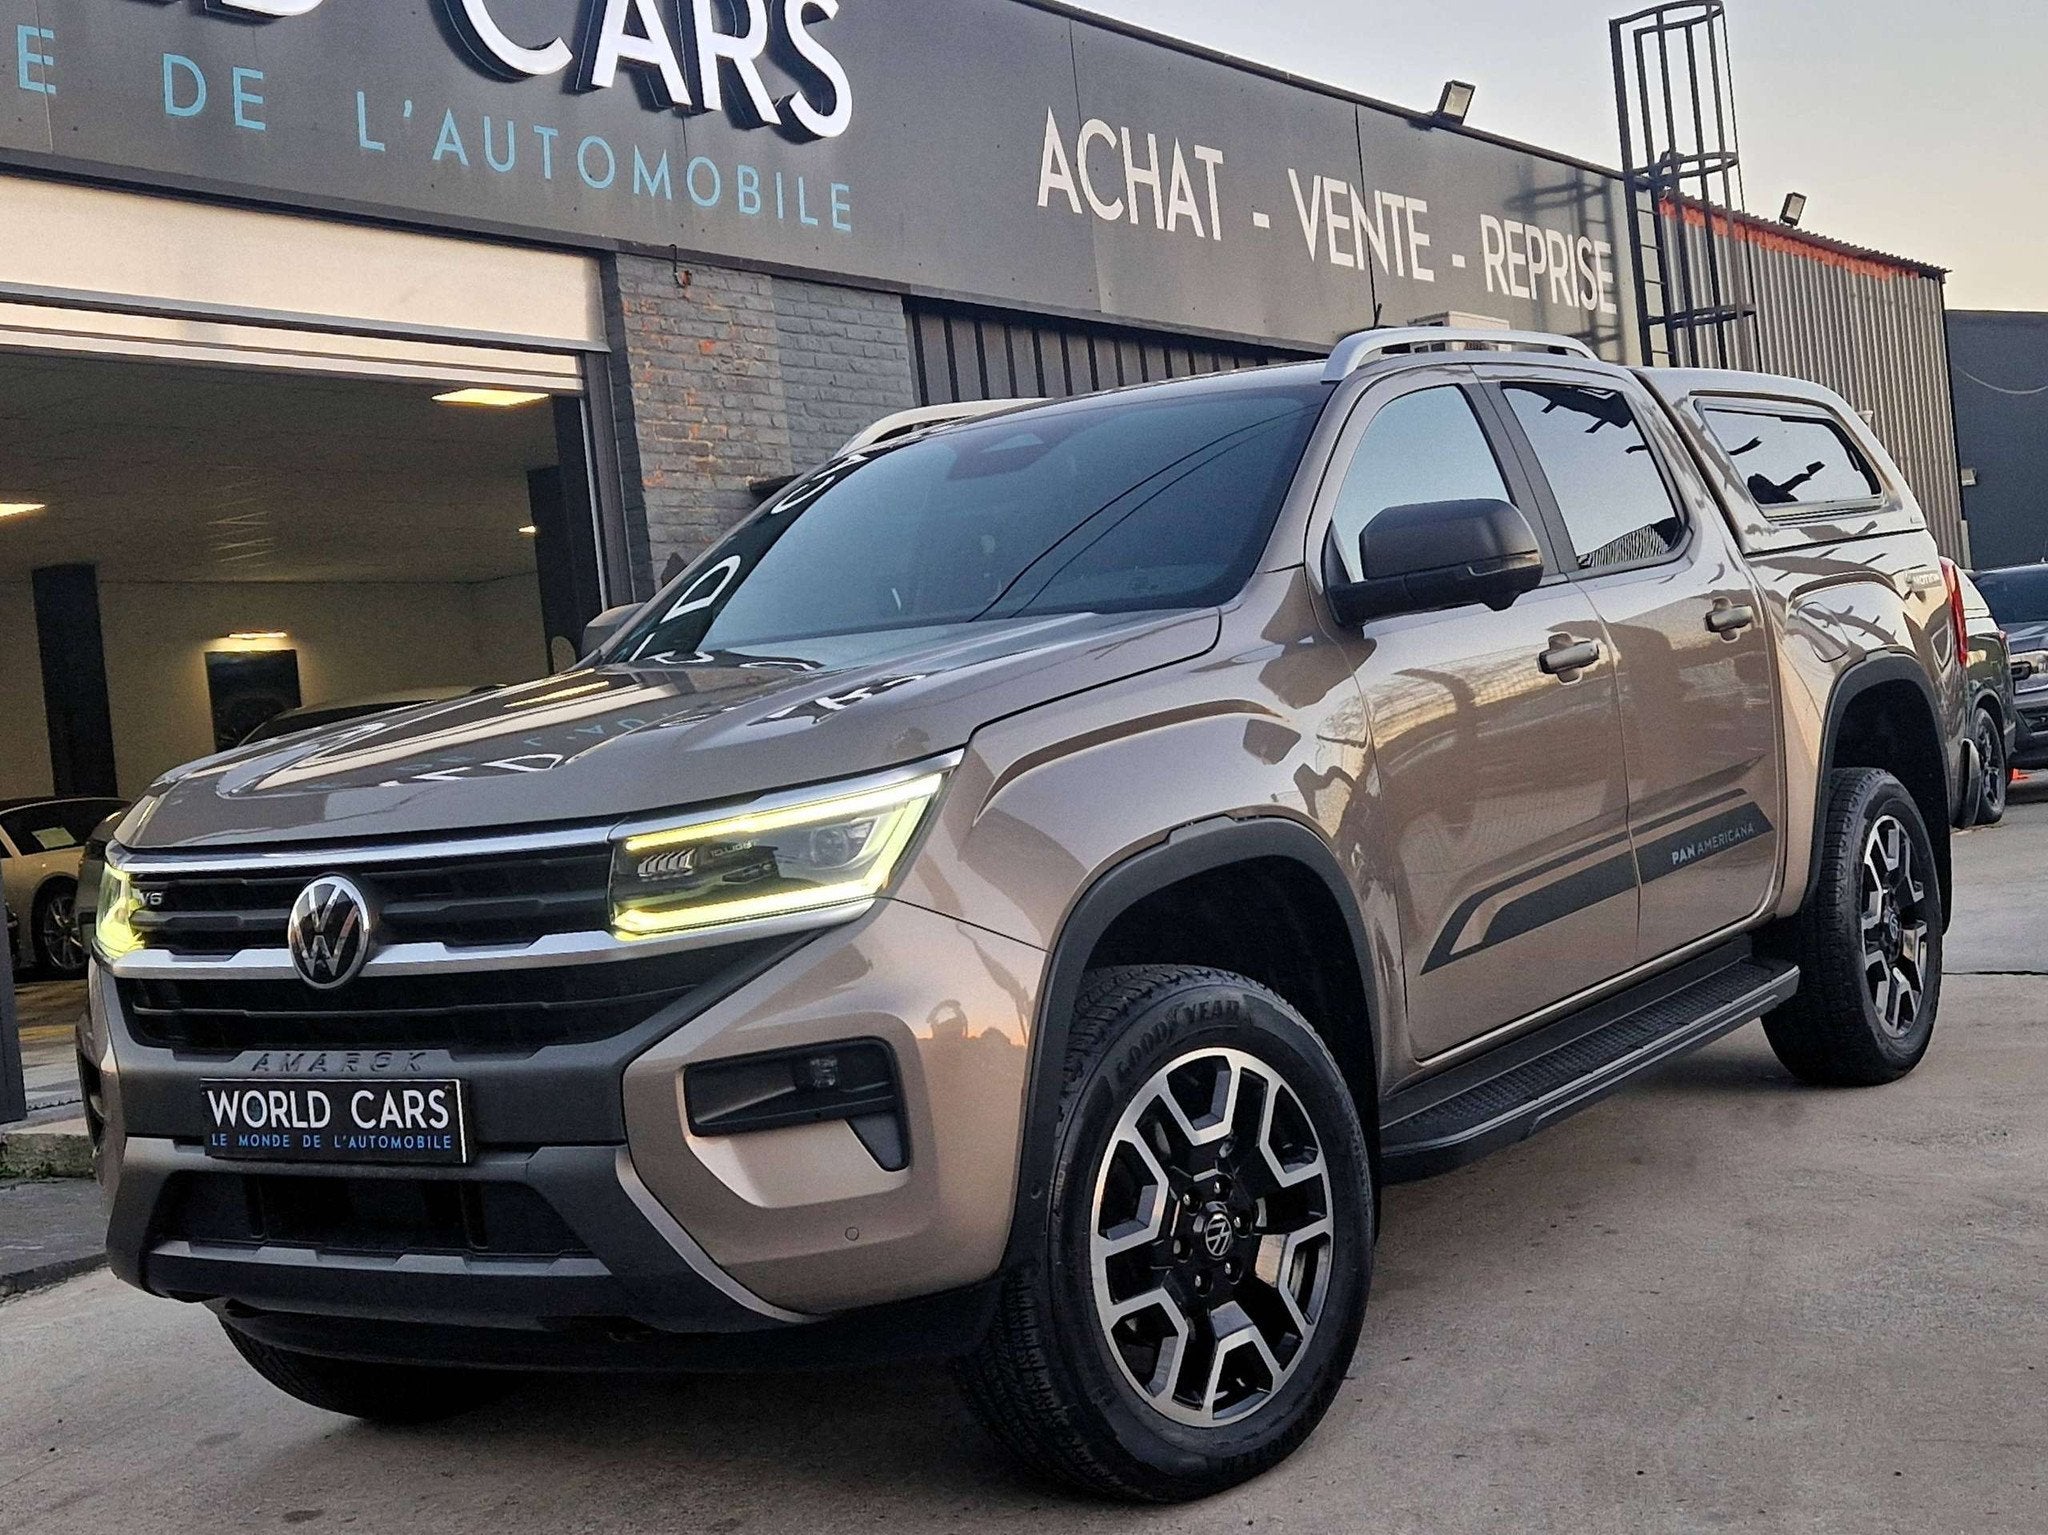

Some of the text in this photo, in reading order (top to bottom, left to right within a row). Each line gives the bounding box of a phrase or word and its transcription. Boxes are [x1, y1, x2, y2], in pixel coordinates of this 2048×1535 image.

[162, 52, 267, 132] DE
[355, 90, 853, 232] L'AUTOMOBILE
[1037, 105, 1224, 241] ACHAT
[1287, 167, 1435, 283] VENTE
[1480, 213, 1618, 315] REPRISE
[139, 892, 163, 906] V6
[251, 1052, 427, 1072] AMAROK
[207, 1089, 450, 1130] WORLD CARS
[211, 1133, 452, 1150] LE MONDE DE L'AUTOMOBILE
